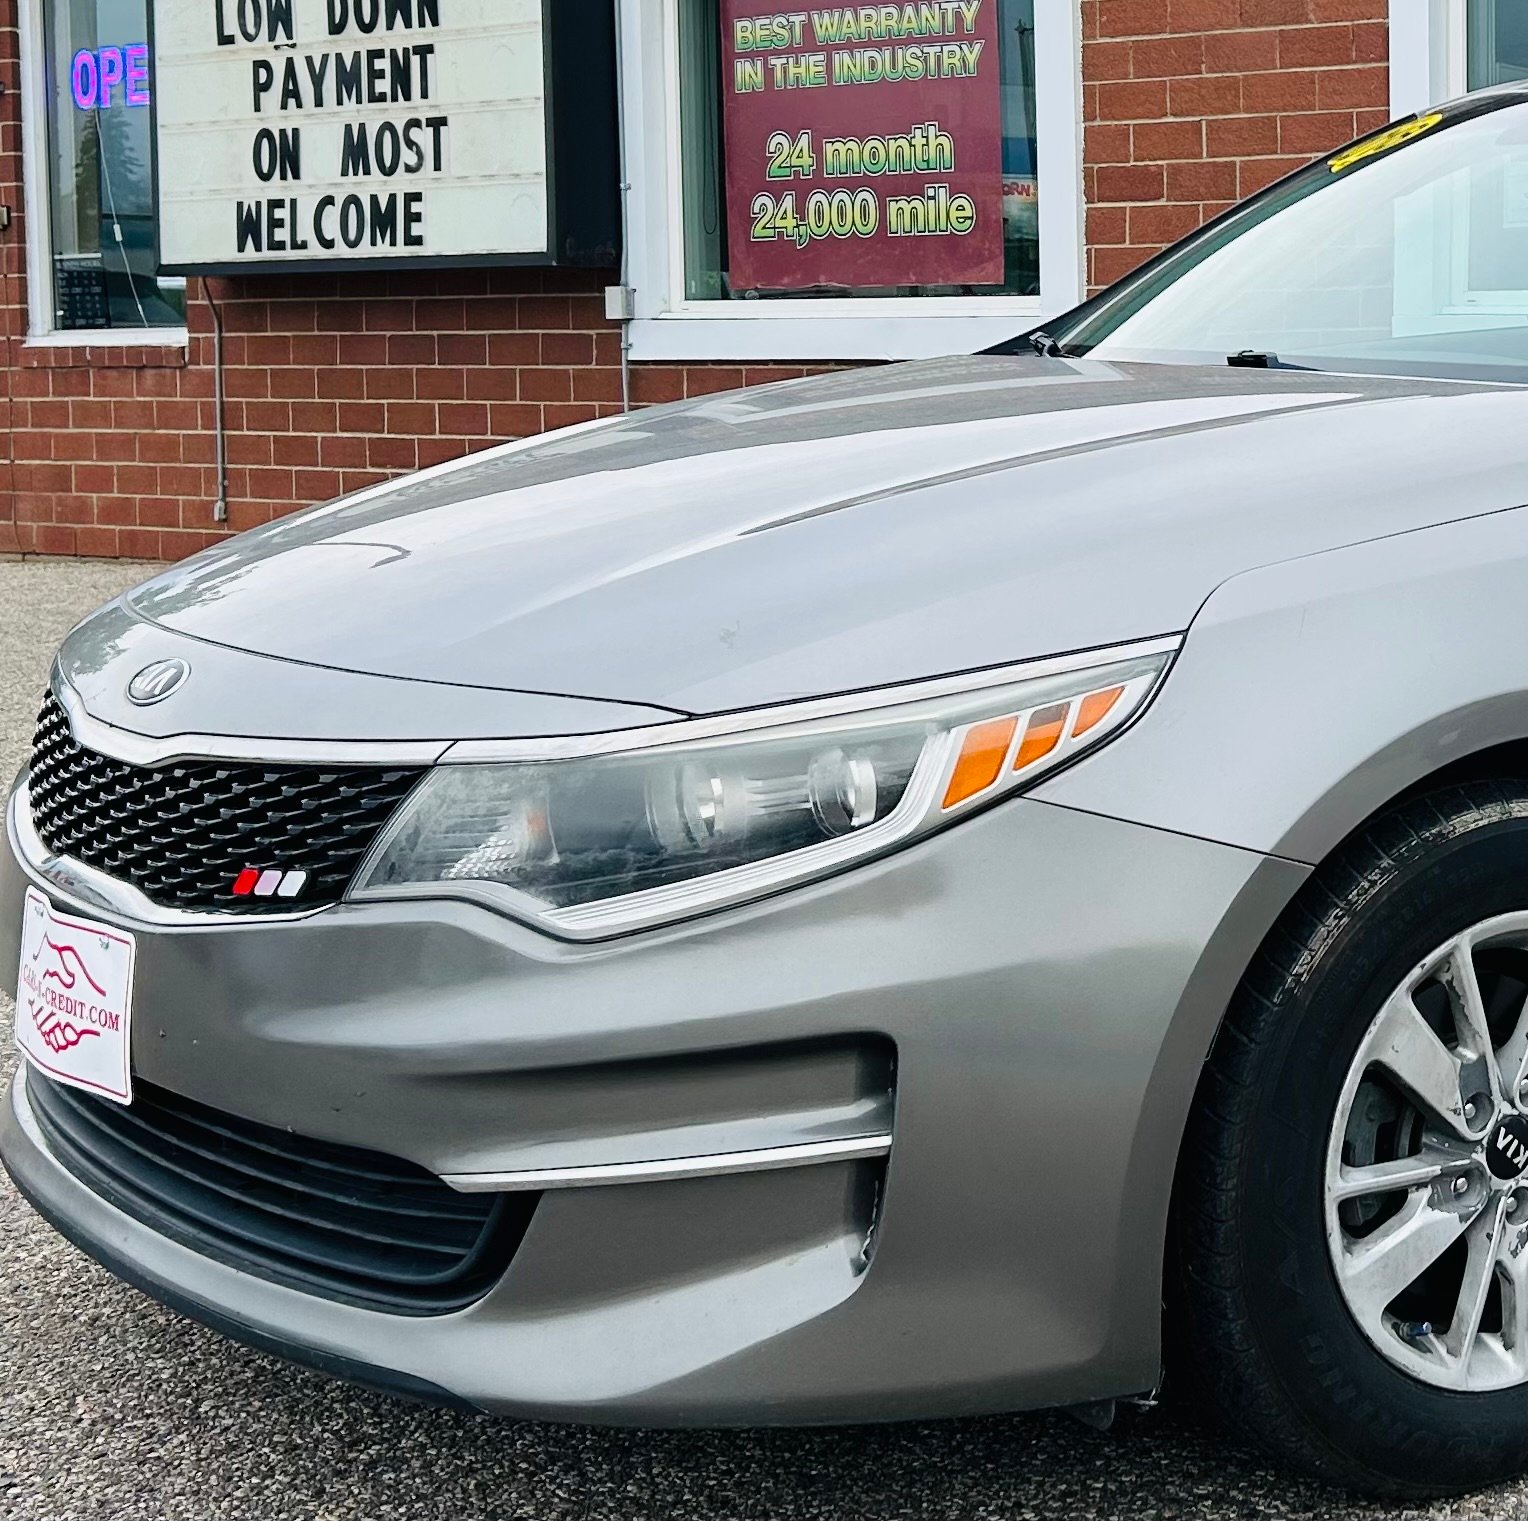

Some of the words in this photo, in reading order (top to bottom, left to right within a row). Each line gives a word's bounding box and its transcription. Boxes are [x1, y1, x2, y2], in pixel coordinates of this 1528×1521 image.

[216, 0, 294, 45] LOW
[327, 0, 440, 35] DOWN
[734, 12, 807, 53] BEST
[810, 0, 983, 44] WARRANTY
[70, 43, 151, 111] OPE
[252, 43, 435, 113] PAYMENT
[734, 56, 765, 94] IN
[768, 53, 828, 90] THE
[833, 40, 986, 84] INDUSTRY
[252, 127, 302, 182] ON
[340, 115, 449, 177] MOST
[765, 129, 816, 181] 24
[823, 120, 955, 178] month
[236, 191, 424, 253] WELCOME
[750, 186, 880, 250] 24,000
[886, 182, 976, 236] mile
